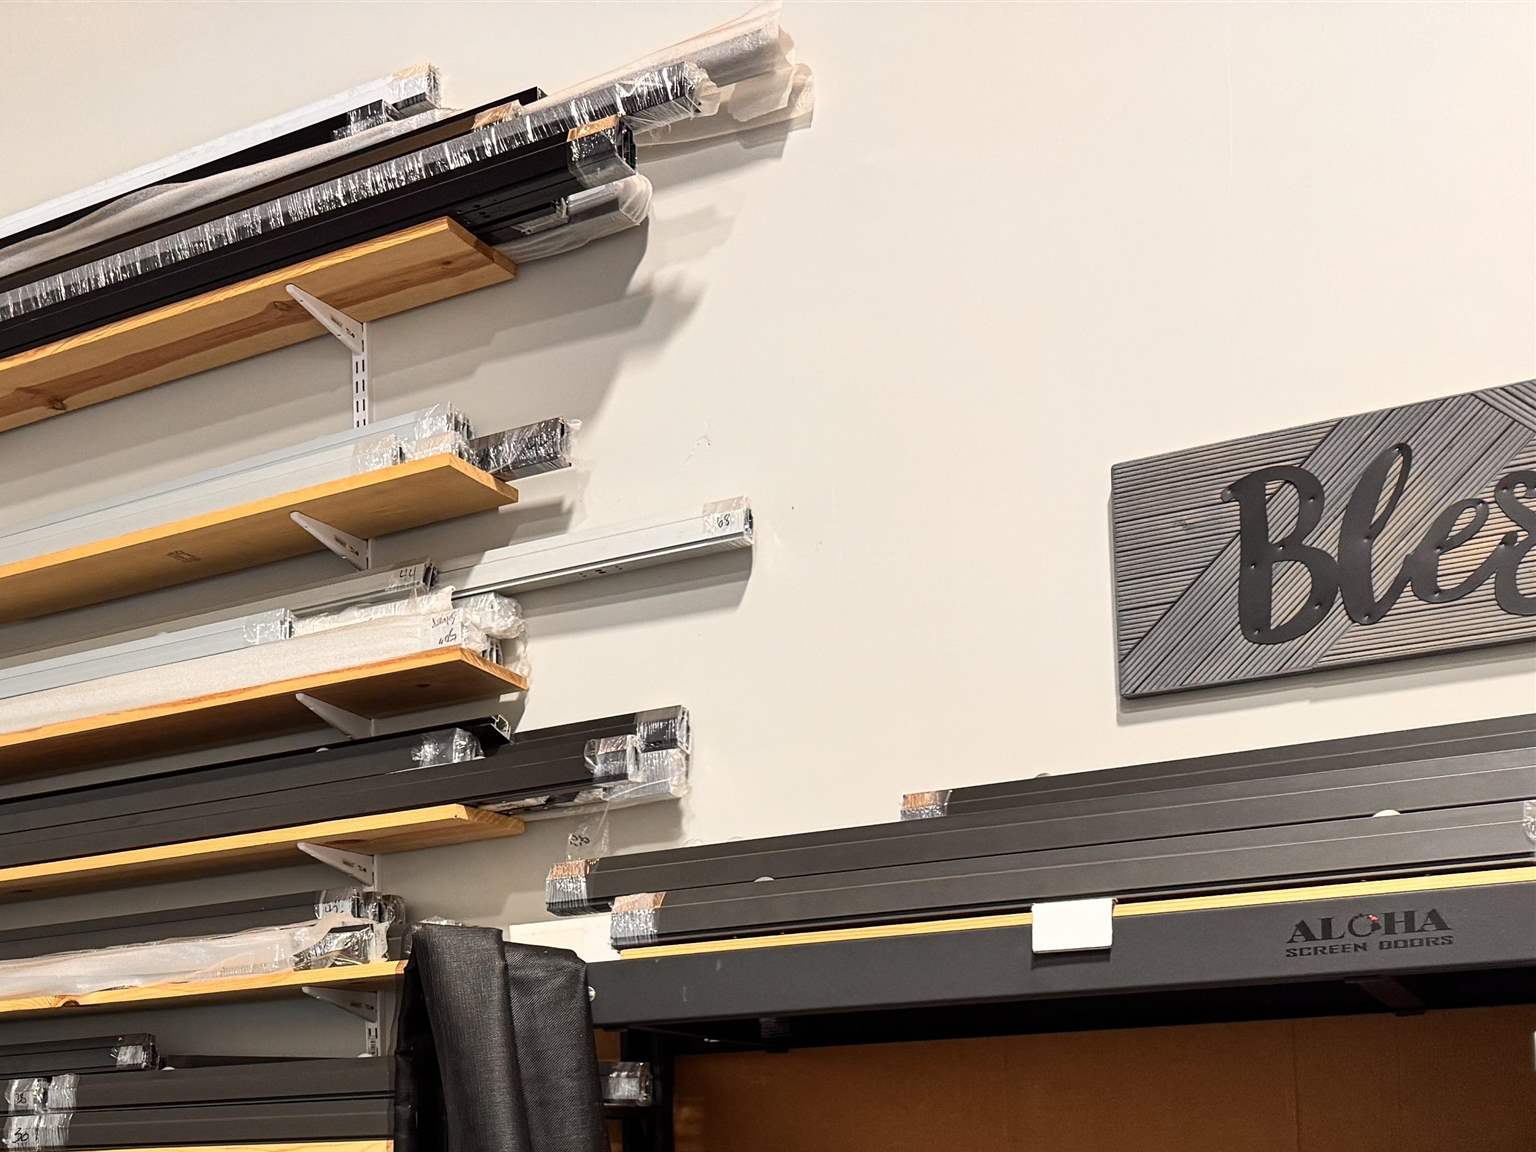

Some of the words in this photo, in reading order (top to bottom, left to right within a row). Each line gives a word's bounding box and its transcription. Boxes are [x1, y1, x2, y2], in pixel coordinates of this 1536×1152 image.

[1287, 908, 1453, 944] ALOHA
[1285, 942, 1368, 958] SCREEN
[1378, 935, 1455, 951] DOORS
